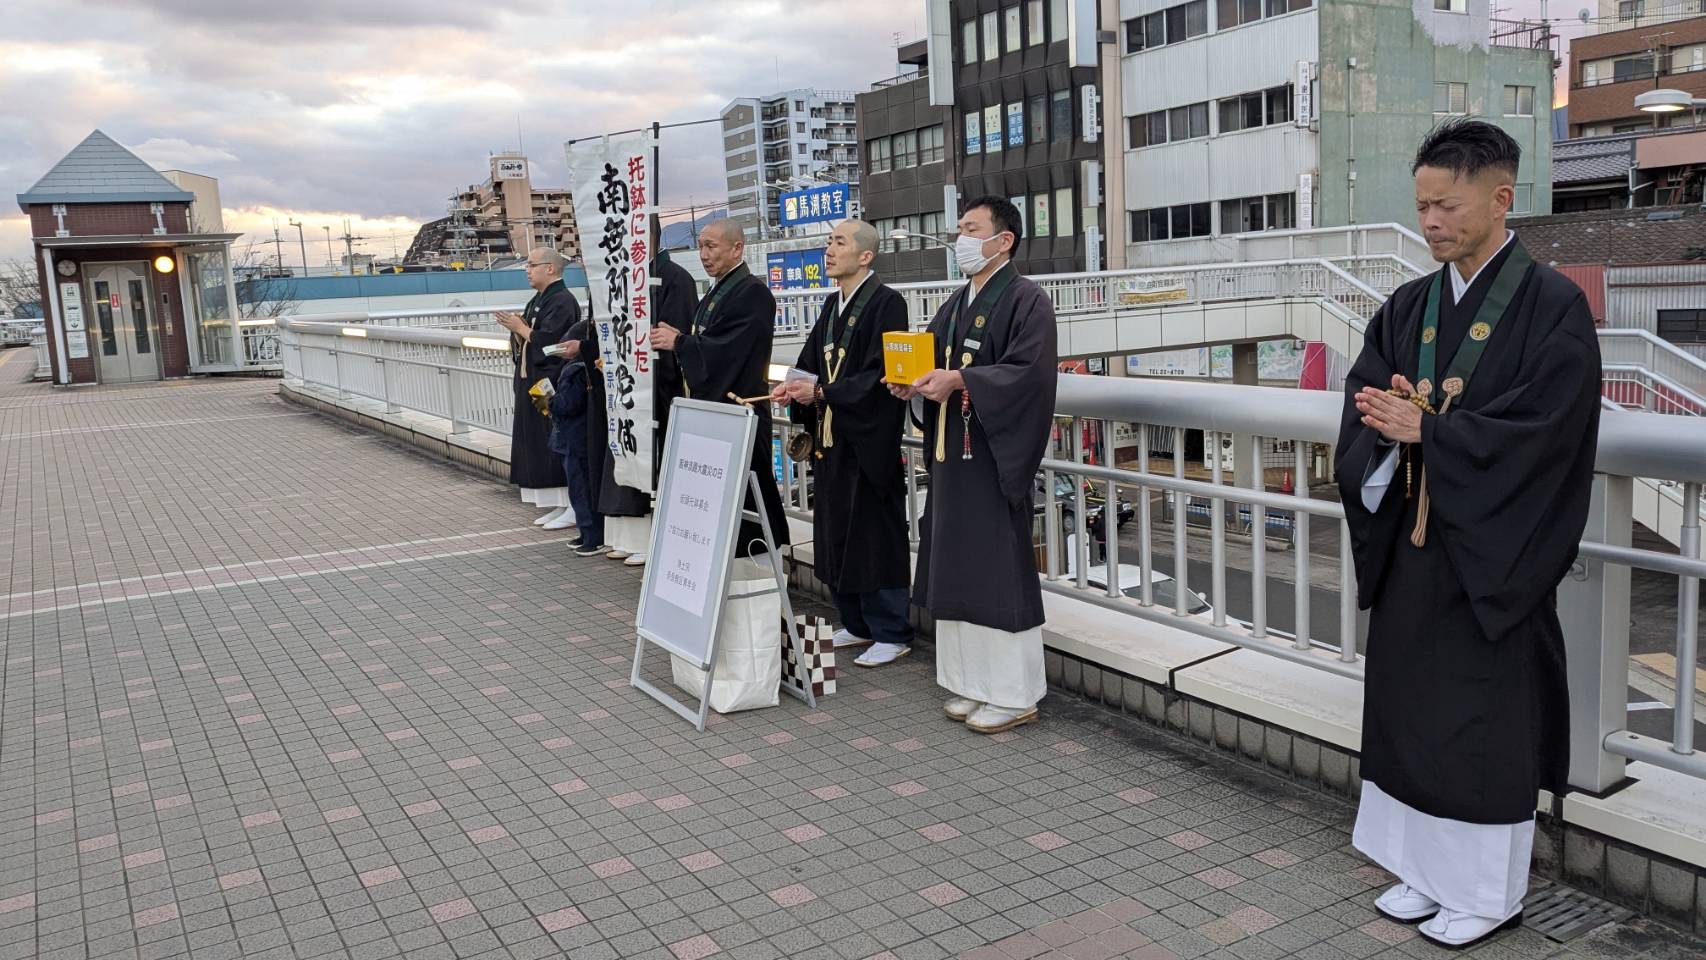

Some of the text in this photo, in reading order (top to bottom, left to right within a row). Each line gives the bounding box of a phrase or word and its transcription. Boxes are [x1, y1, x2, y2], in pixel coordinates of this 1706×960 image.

[628, 155, 649, 373] 托鉢に参りました
